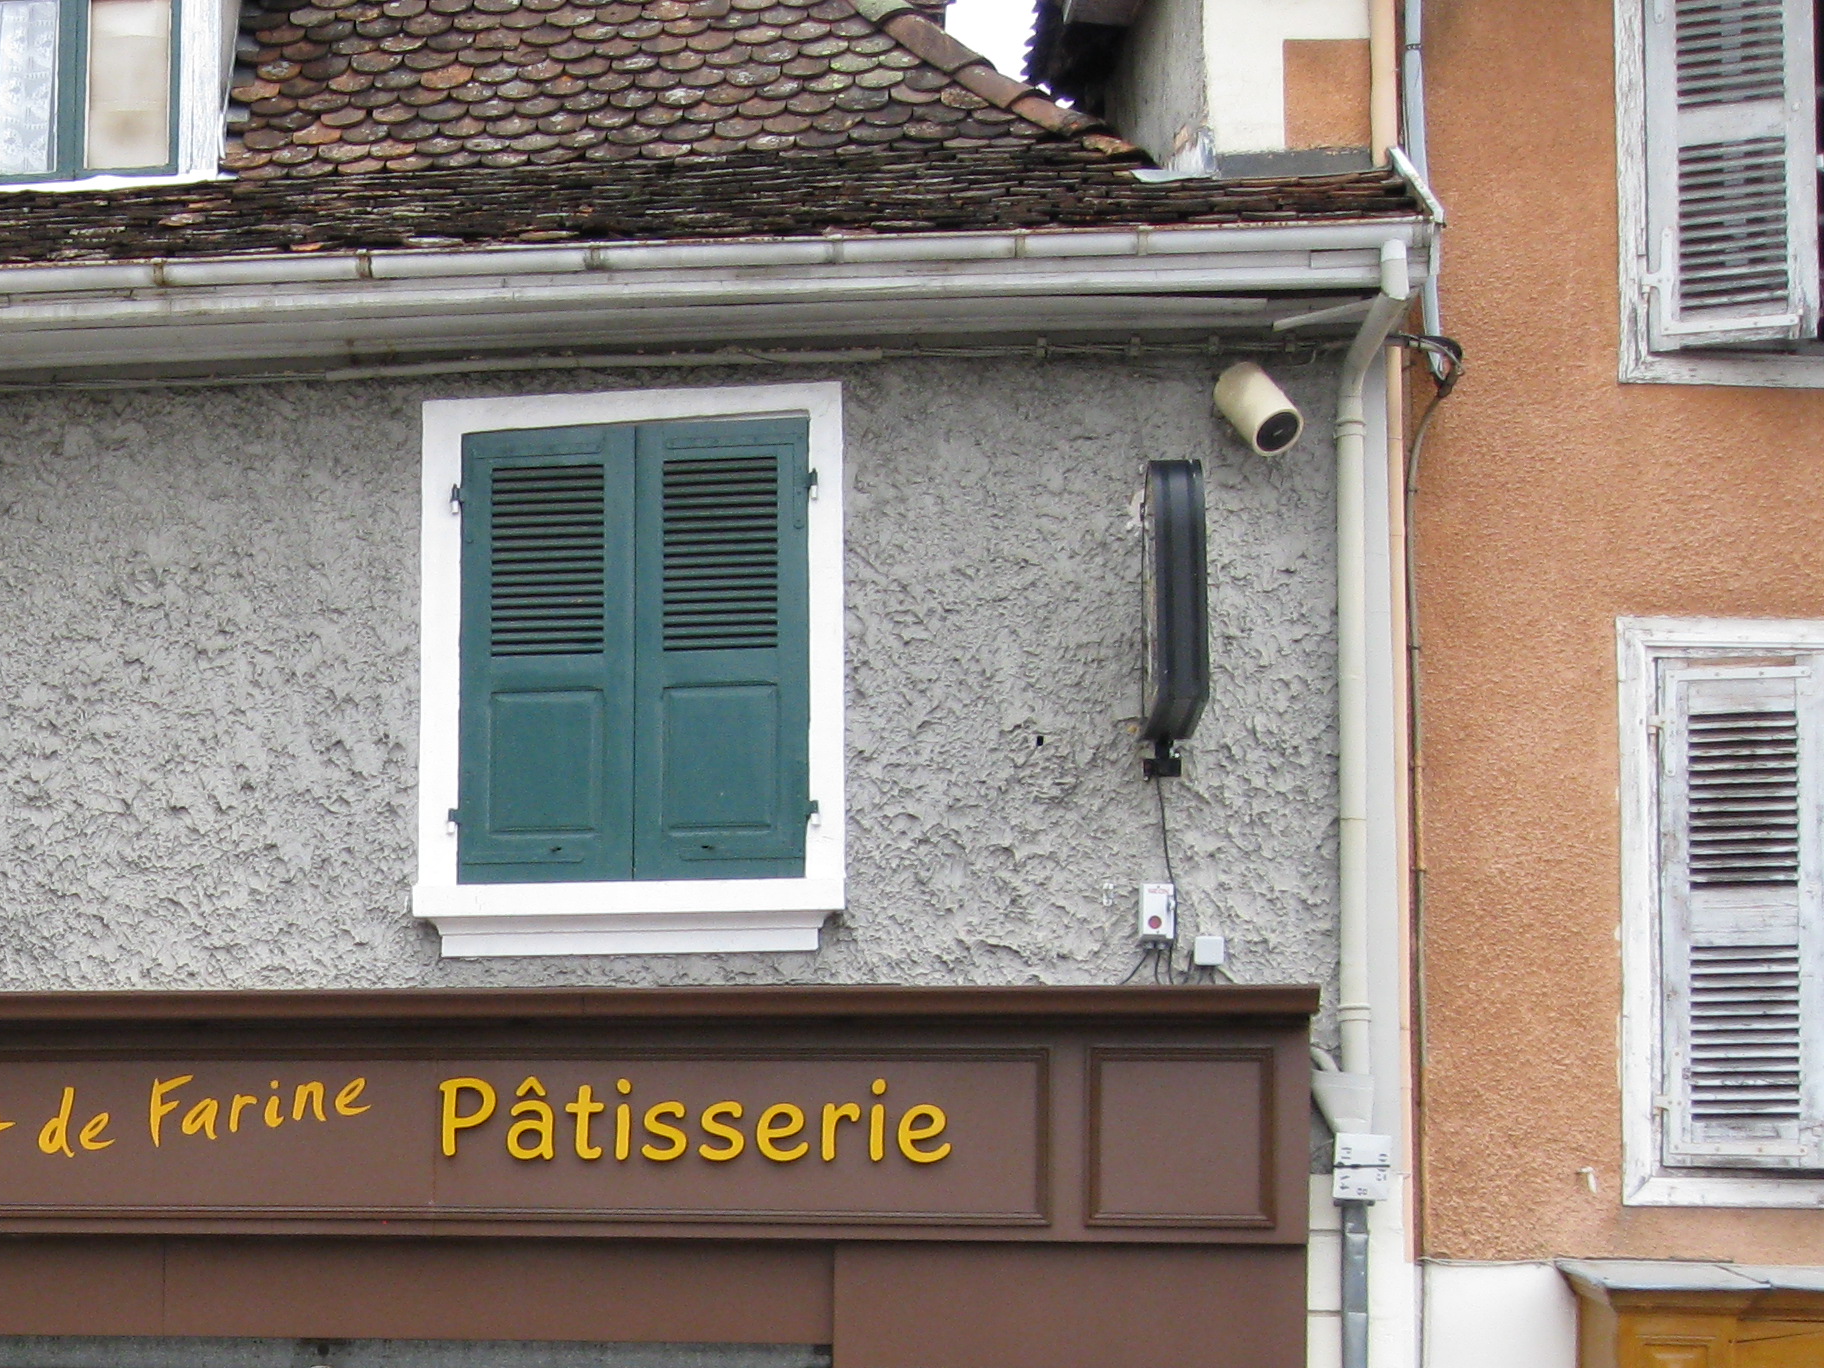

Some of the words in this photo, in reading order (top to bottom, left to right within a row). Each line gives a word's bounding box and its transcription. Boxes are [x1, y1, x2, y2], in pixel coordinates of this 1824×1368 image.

[37, 1086, 116, 1157] de
[149, 1073, 373, 1148] Farine
[438, 1076, 952, 1164] Pâtisserie
